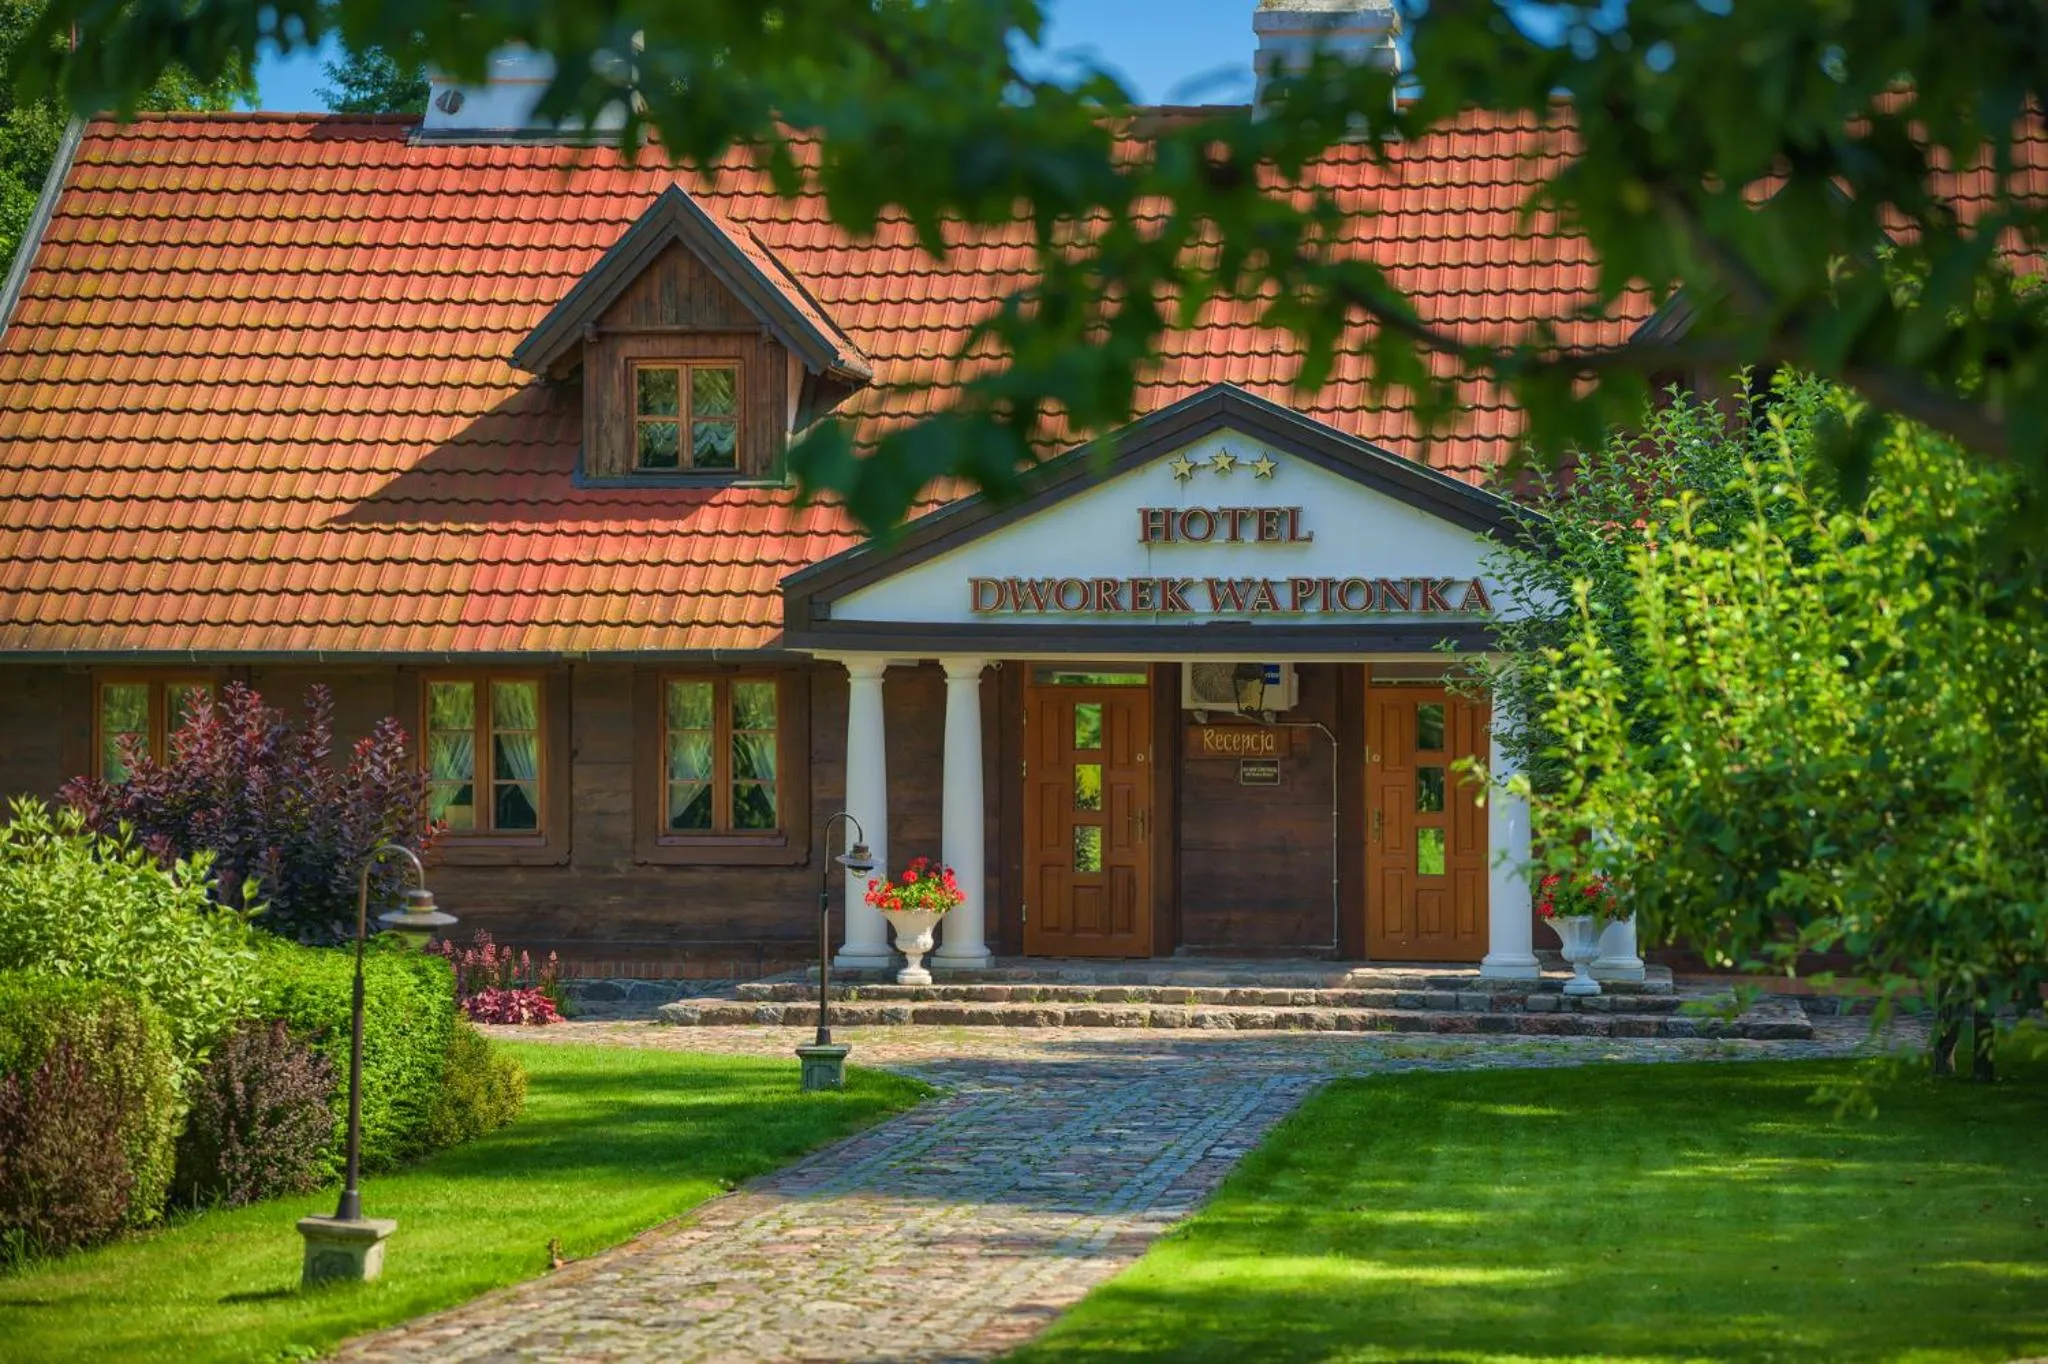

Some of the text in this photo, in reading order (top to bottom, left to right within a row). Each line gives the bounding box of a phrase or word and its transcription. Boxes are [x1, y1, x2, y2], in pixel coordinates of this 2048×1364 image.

[1137, 507, 1314, 543] HOTEL
[968, 576, 1495, 613] DWOREK WAPIONKA
[1203, 729, 1275, 754] Recepcja
